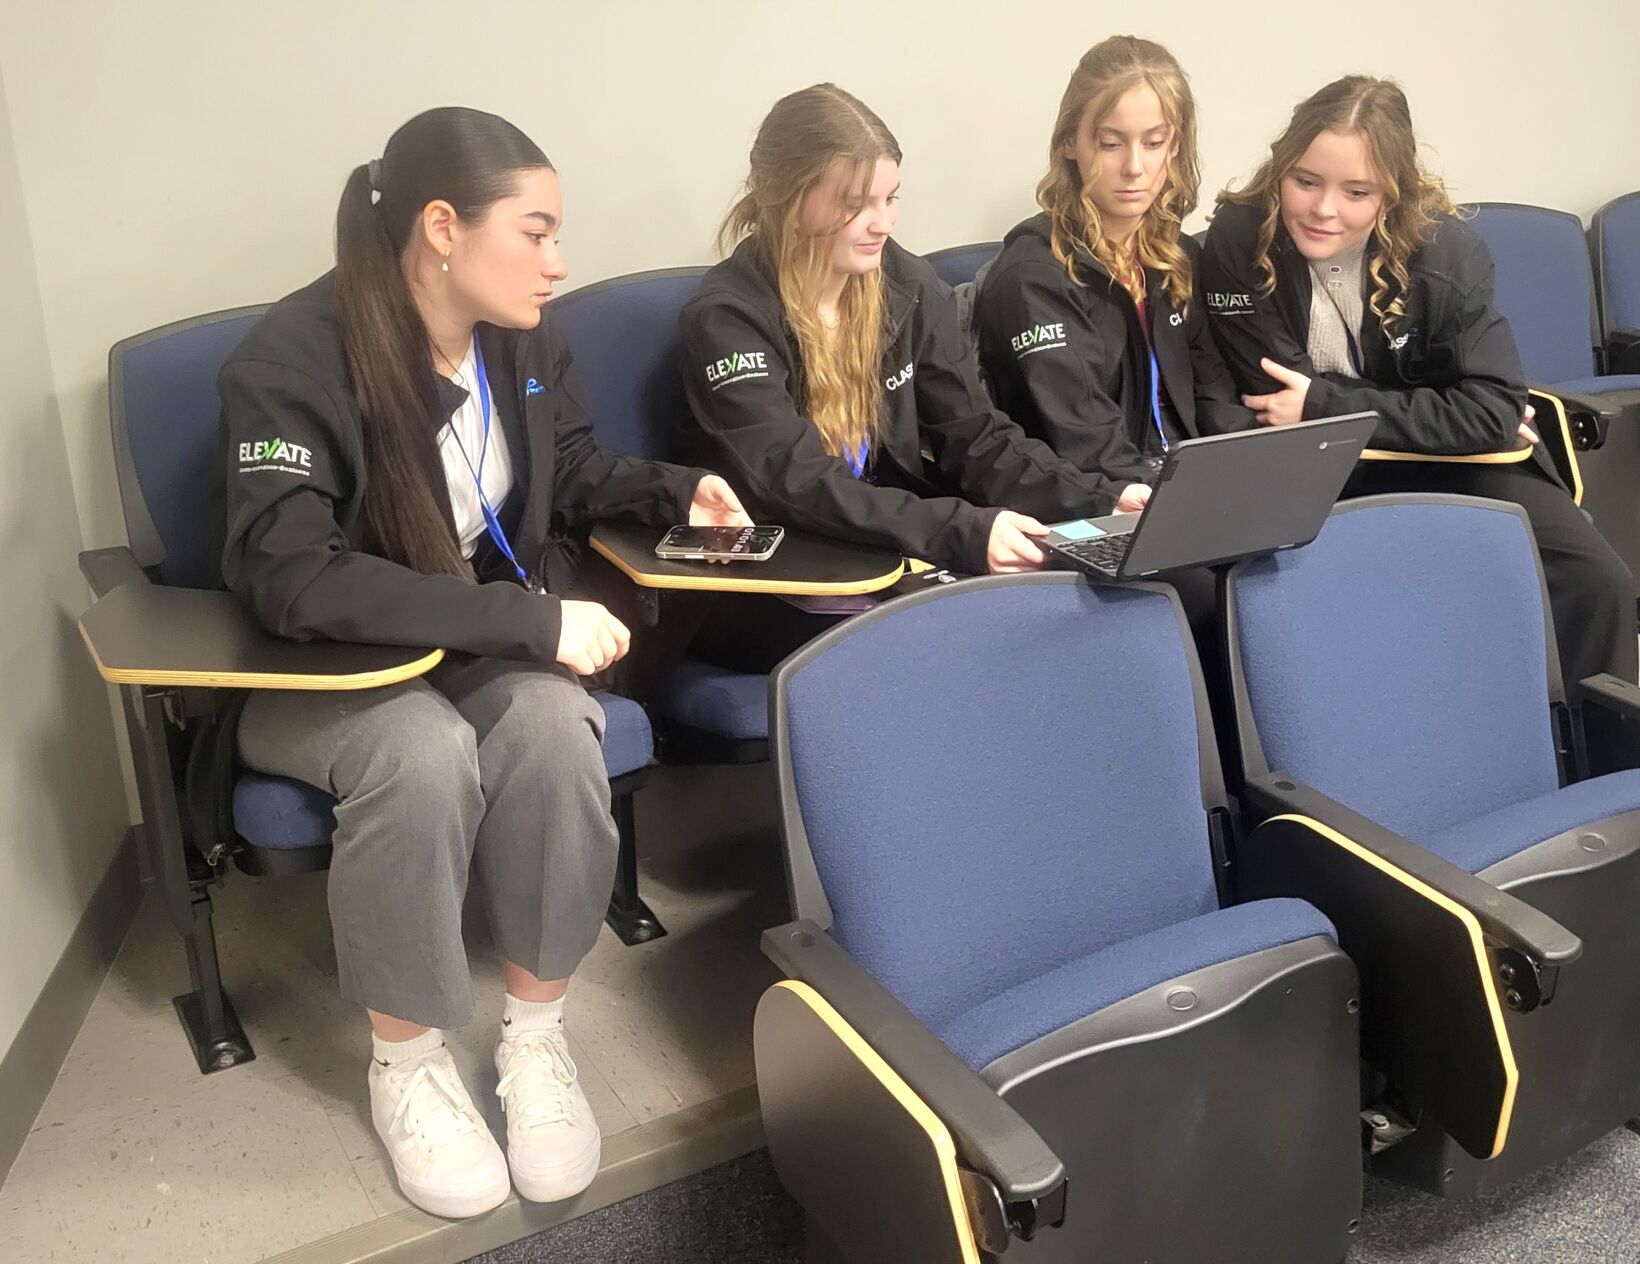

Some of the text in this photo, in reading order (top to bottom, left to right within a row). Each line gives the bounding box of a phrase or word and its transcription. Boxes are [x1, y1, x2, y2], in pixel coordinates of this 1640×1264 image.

[1207, 292, 1253, 307] ELEVATE
[1011, 323, 1066, 352] ELEVATE
[706, 351, 768, 382] ELEVATE
[885, 361, 914, 391] CLAS
[239, 437, 313, 467] ELEVATE
